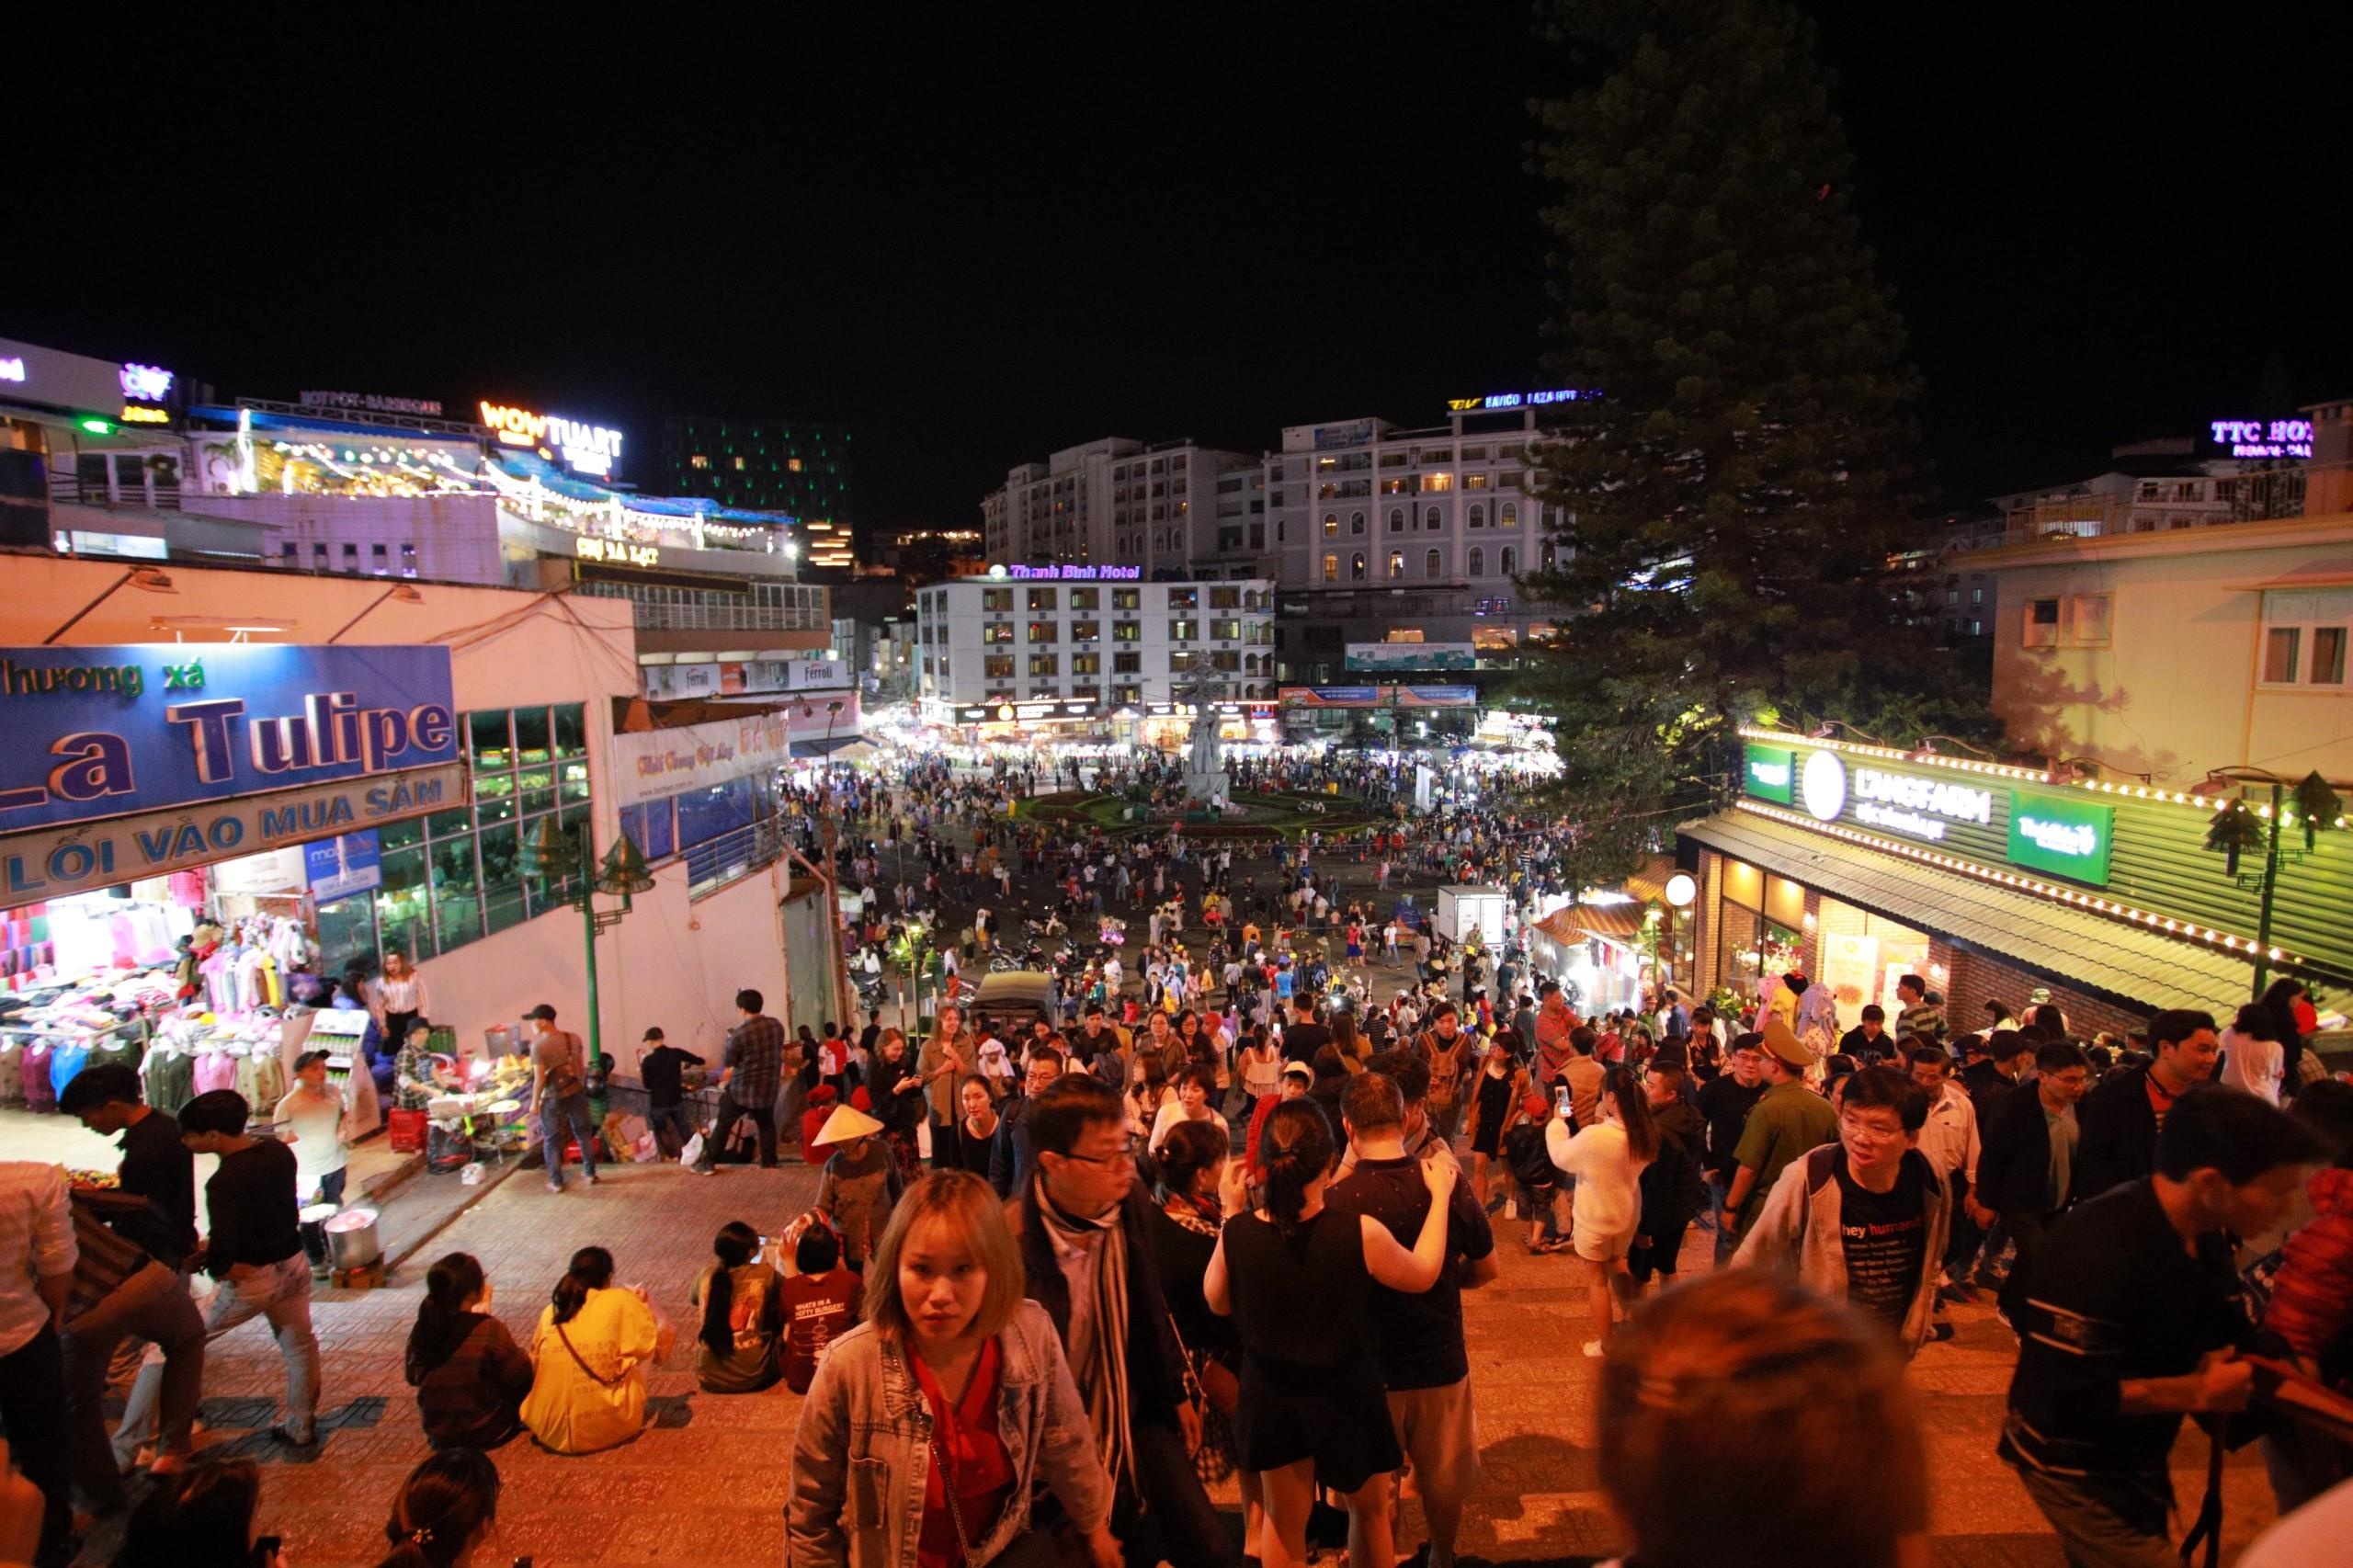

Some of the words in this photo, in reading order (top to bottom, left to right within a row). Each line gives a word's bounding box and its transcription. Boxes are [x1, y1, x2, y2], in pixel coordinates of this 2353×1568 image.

[480, 401, 546, 438] WOW
[2211, 421, 2261, 443] TTC
[1010, 564, 1059, 578] Thanh
[1100, 564, 1140, 578] Hotel
[2, 659, 144, 698] hương
[163, 655, 207, 690] xá
[804, 666, 833, 682] Ferroli
[166, 691, 453, 785] Tulipe
[6, 826, 116, 893] LỐI
[133, 815, 244, 865] VÀO
[260, 794, 355, 839] MUA
[1842, 1223, 1866, 1239] hey
